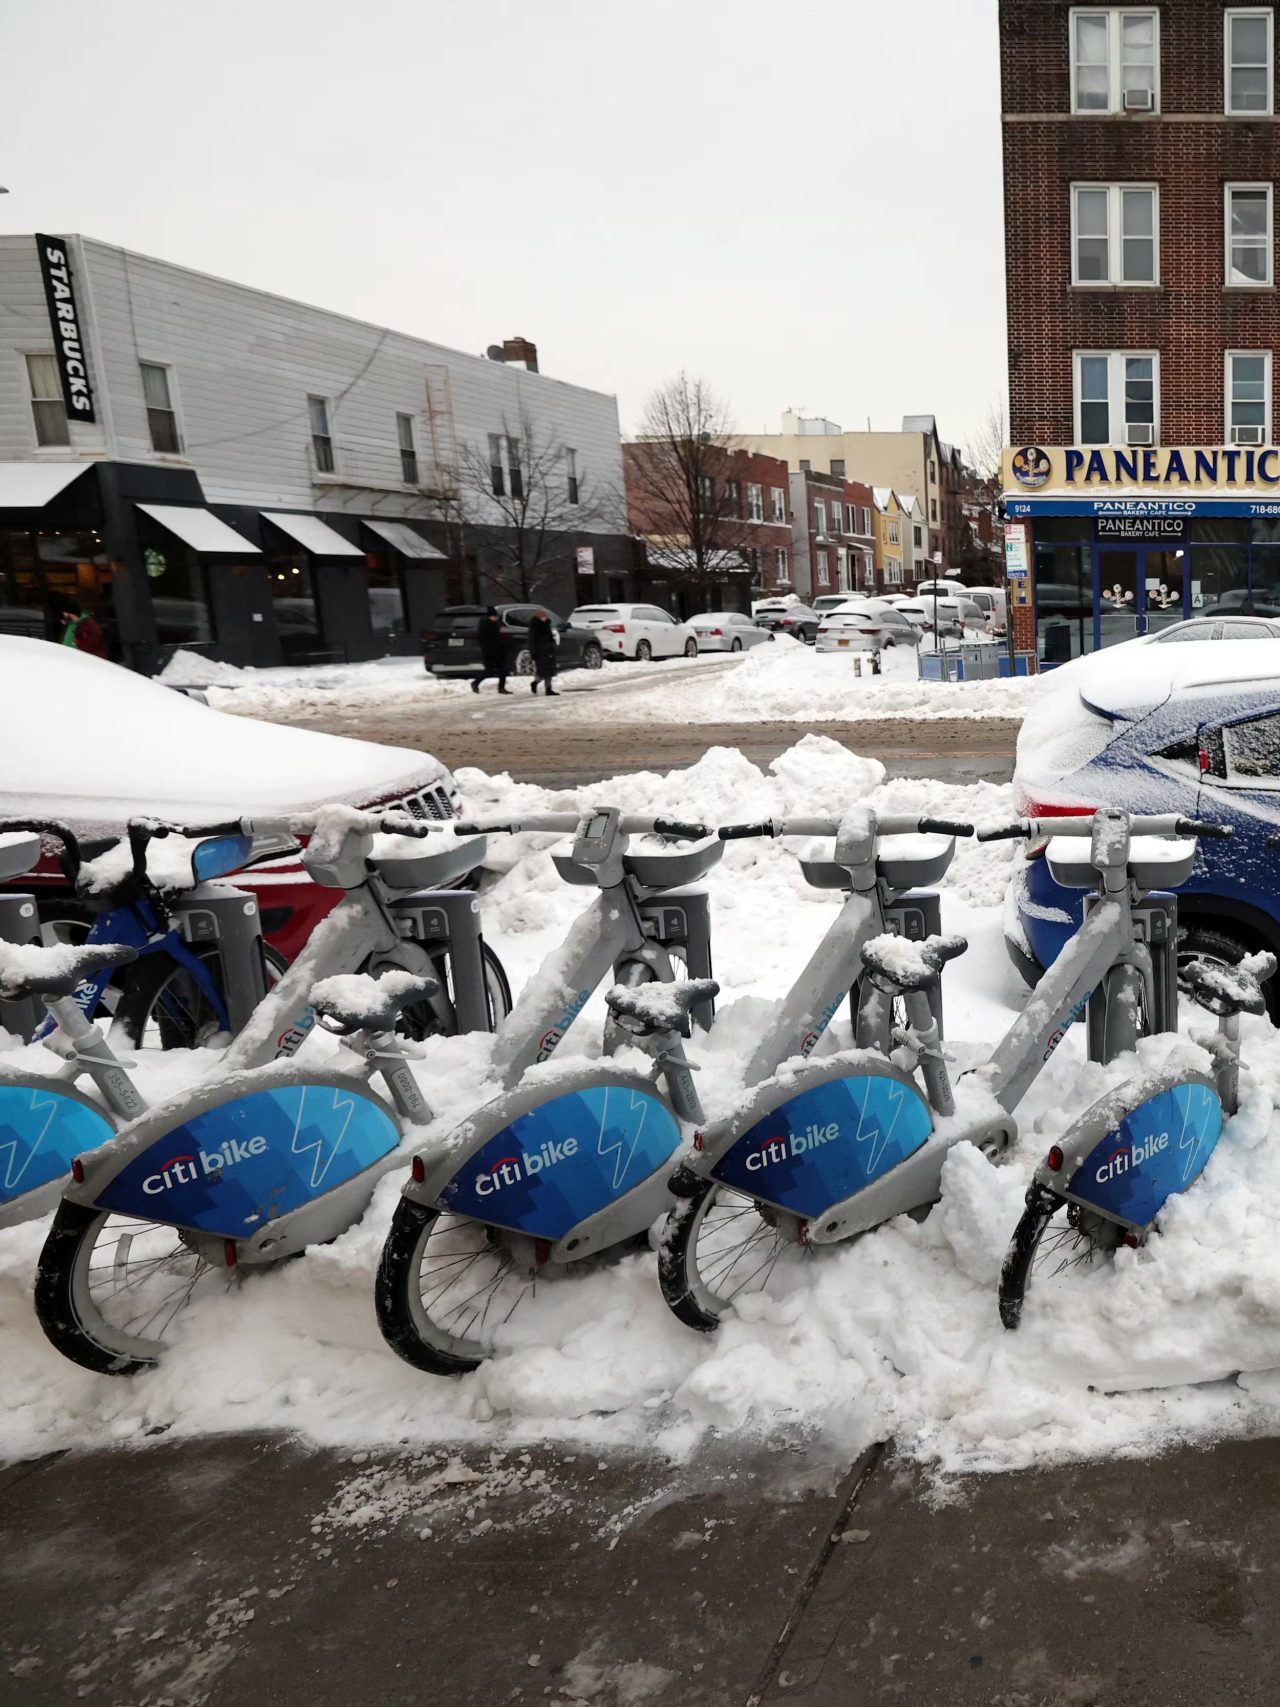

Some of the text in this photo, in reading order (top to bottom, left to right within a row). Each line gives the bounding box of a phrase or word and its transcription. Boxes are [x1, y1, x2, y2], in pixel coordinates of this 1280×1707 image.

[46, 247, 91, 411] STARBUCKS
[1014, 505, 1031, 513] 9124
[1093, 502, 1196, 511] PANEANTICO
[1098, 518, 1183, 531] PANEANTICO
[142, 1136, 268, 1195] citi bike
[475, 1138, 579, 1196] citi bike
[745, 1123, 839, 1171] citi bike
[1095, 1132, 1169, 1184] citi bike
